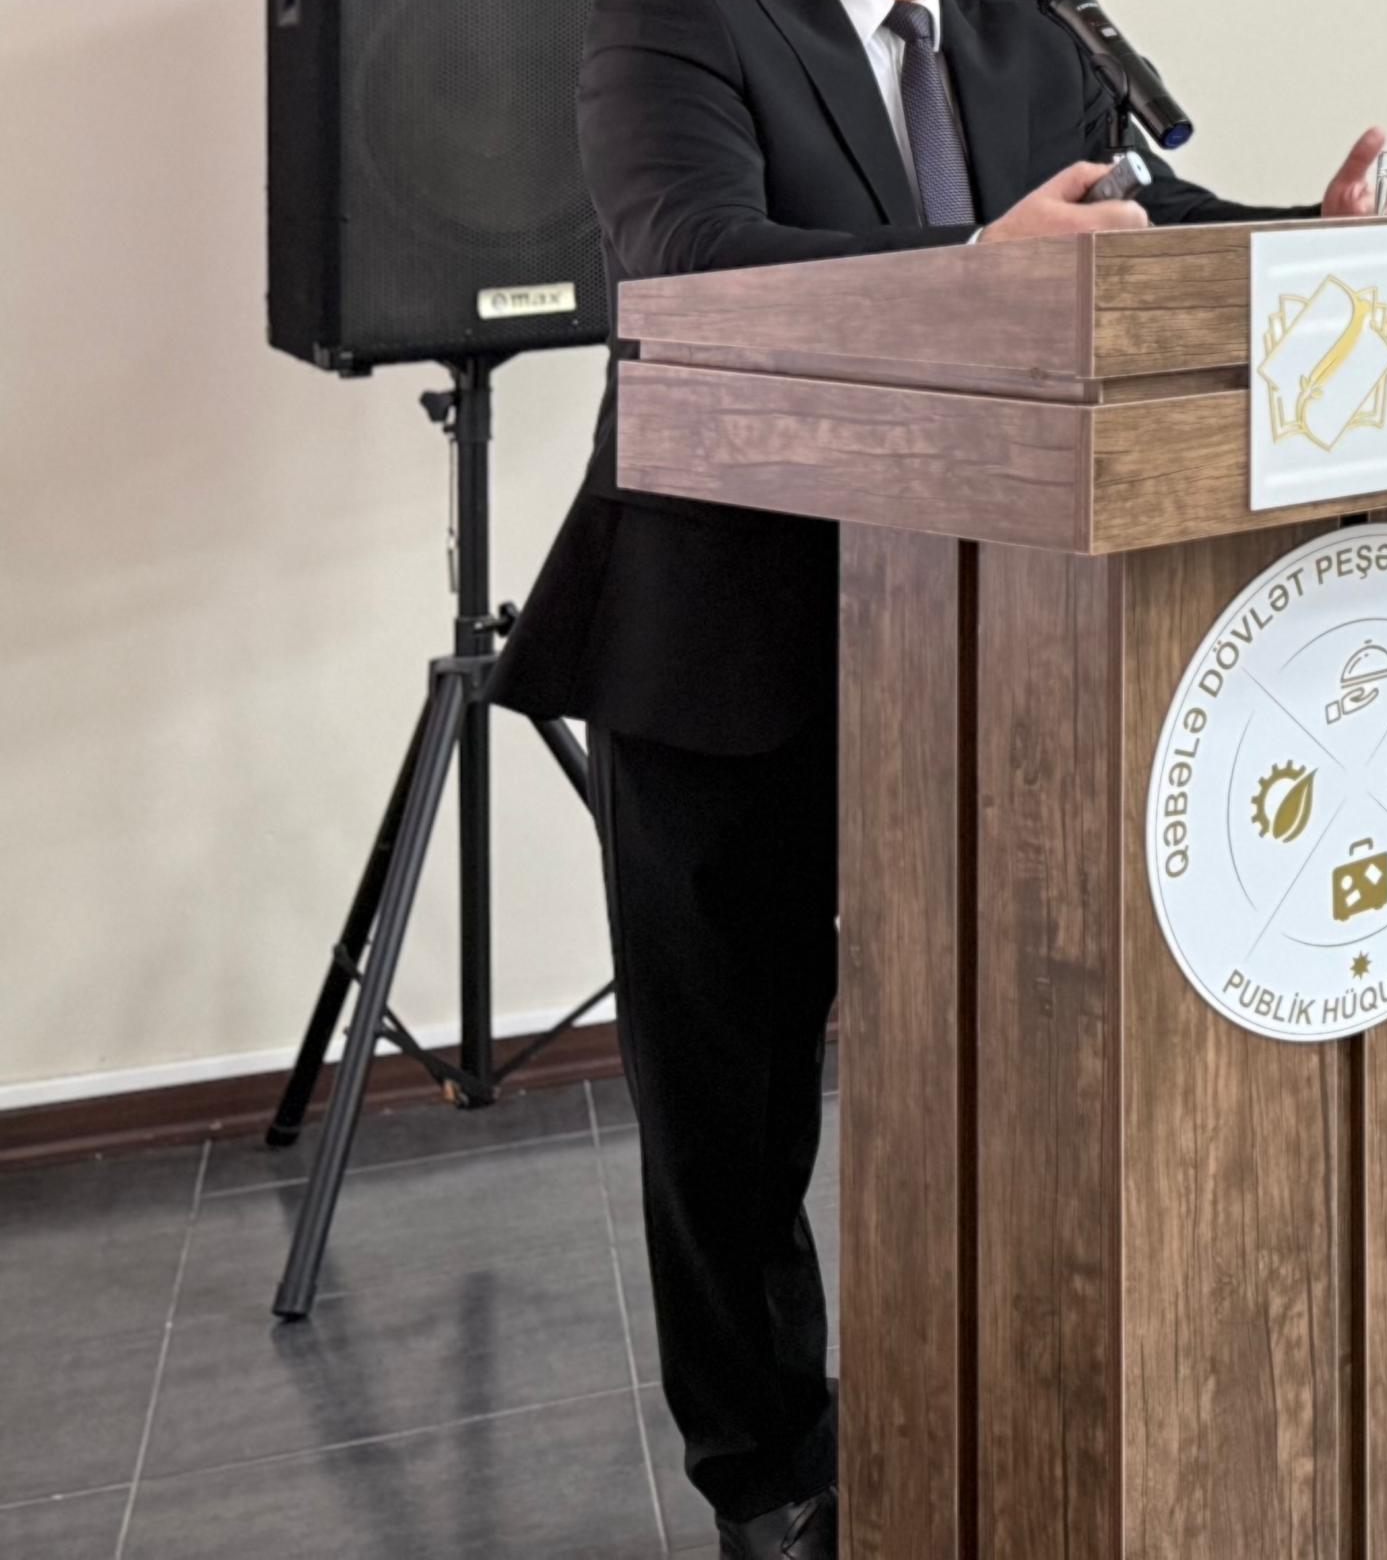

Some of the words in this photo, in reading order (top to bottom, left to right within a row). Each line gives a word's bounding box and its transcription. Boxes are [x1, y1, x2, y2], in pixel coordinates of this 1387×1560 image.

[1164, 706, 1208, 879] QƏBƏLƏ
[1198, 567, 1307, 698] DÖVLƏT
[1221, 968, 1316, 1026] PUBLİK
